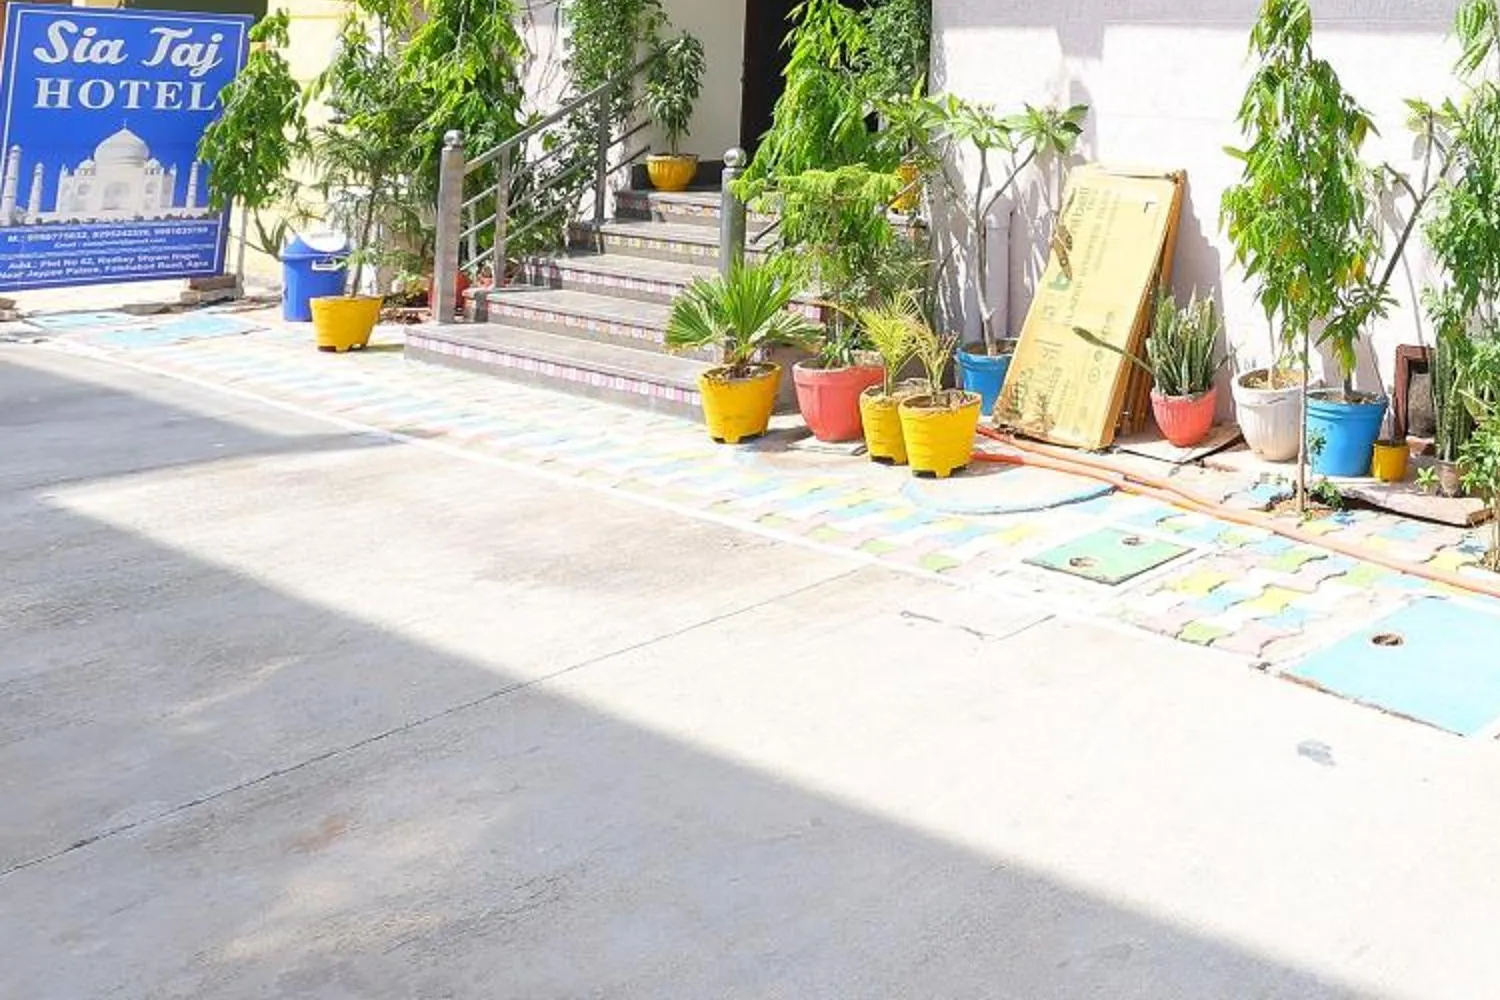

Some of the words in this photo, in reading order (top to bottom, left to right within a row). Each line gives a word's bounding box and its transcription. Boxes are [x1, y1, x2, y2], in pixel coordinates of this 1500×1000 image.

[33, 20, 128, 65] Sia
[142, 26, 224, 76] Taj
[32, 77, 217, 111] HOTEL
